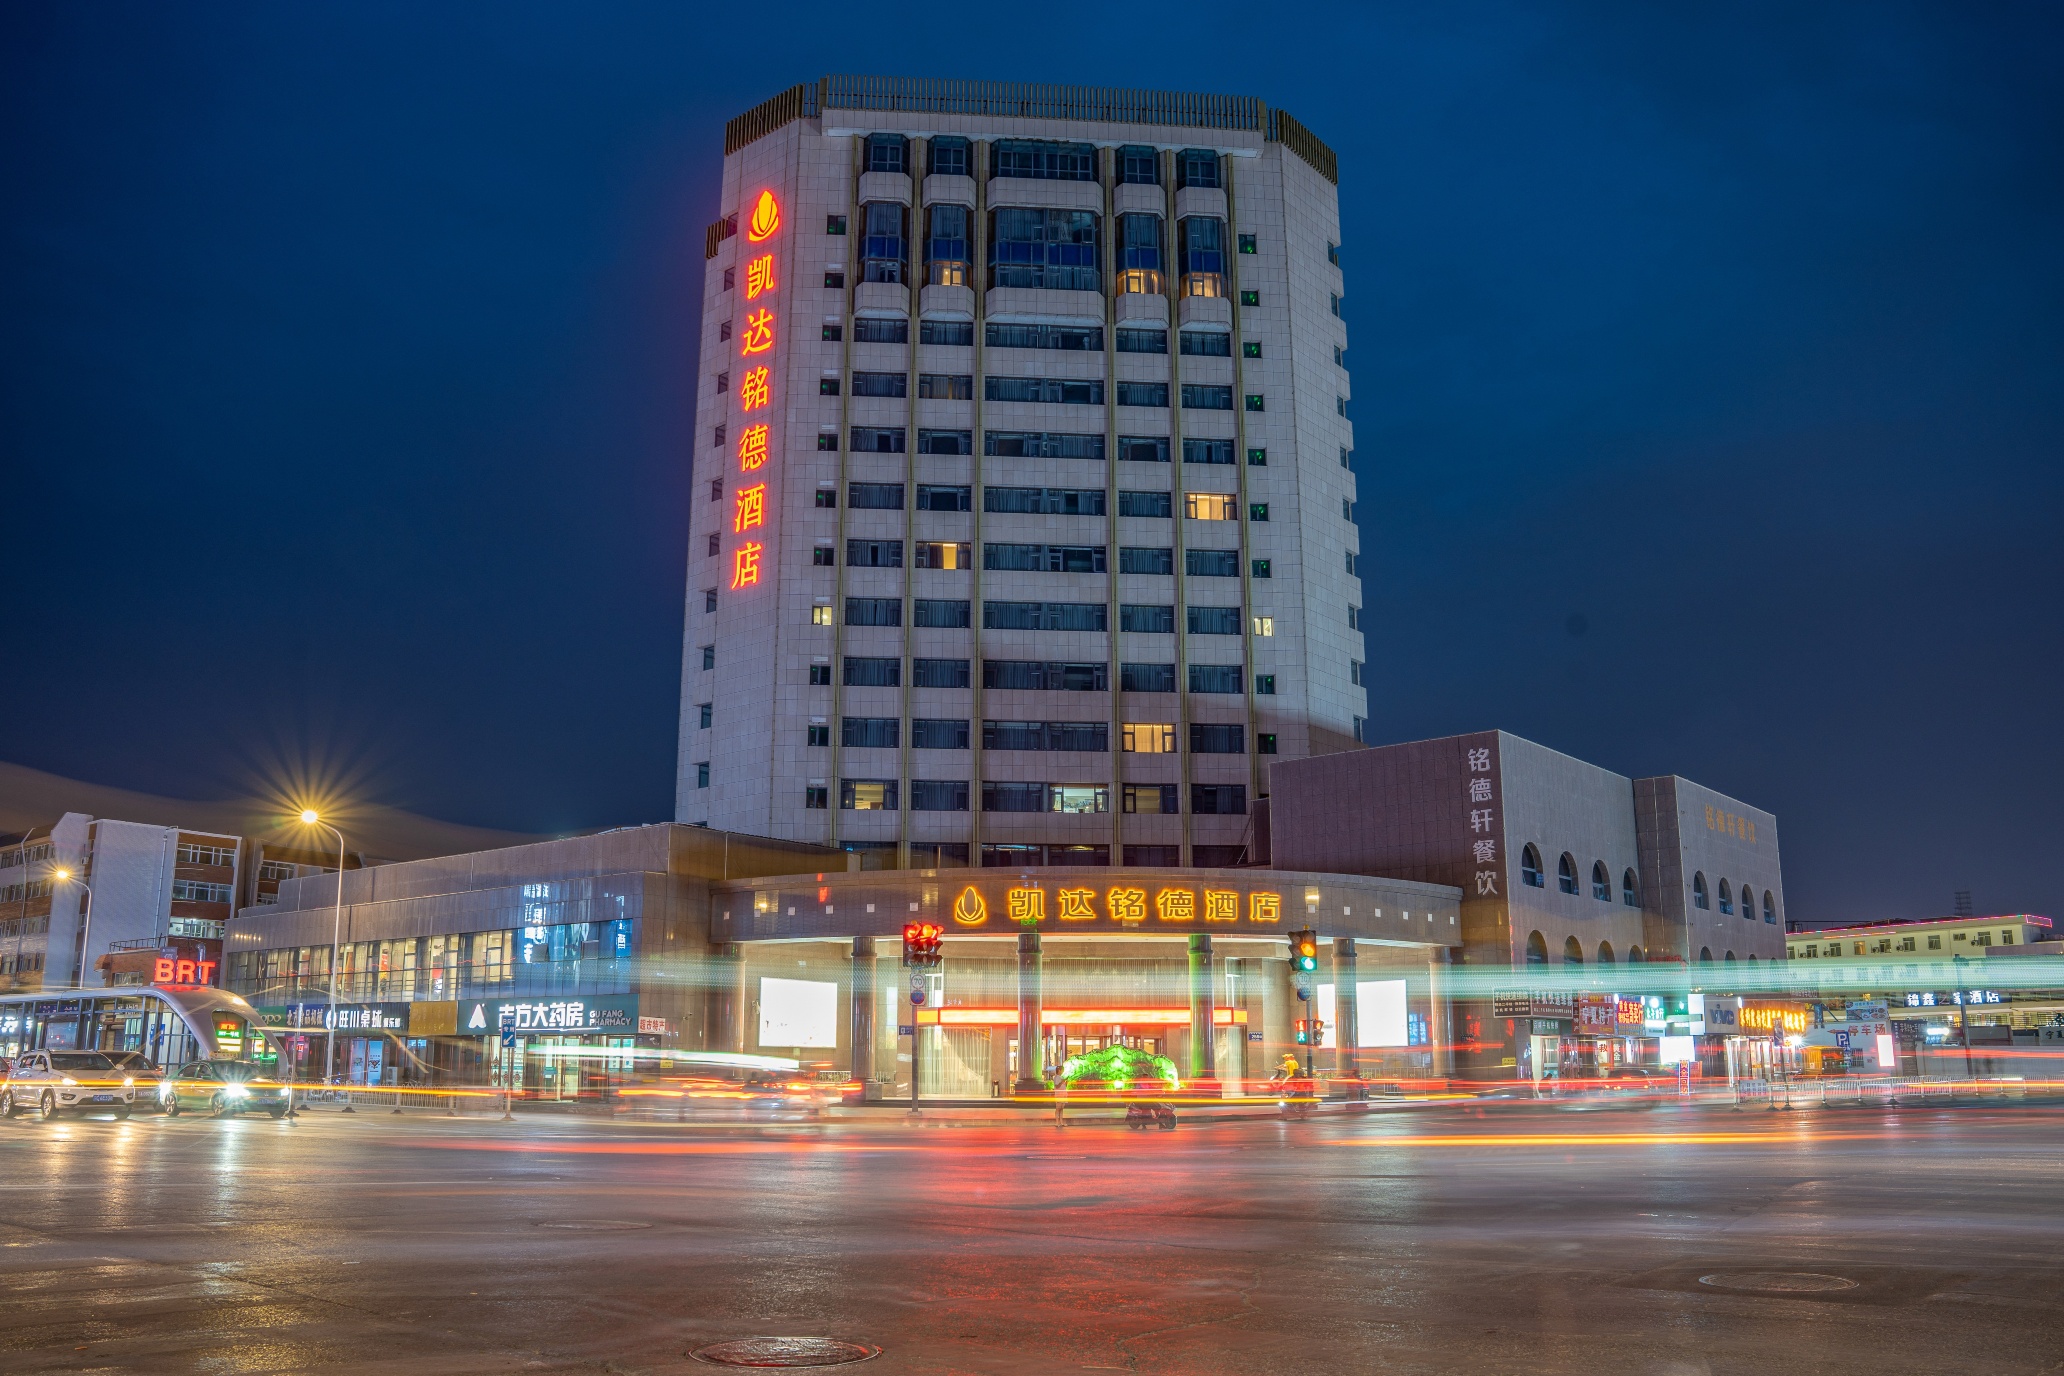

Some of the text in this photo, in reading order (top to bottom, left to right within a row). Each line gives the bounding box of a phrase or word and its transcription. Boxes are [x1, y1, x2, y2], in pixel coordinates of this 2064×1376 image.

[732, 254, 775, 590] 凯达铭德酒店
[1467, 747, 1498, 896] 铭德轩餐饮
[1008, 887, 1282, 922] 凯达铭德酒店
[154, 958, 216, 985] BRT
[339, 1009, 382, 1028] 旺川桌球
[590, 1009, 623, 1018] GU FANG
[590, 1017, 632, 1026] PHARMACY
[1837, 1033, 1847, 1046] P
[1848, 1024, 1886, 1037] 停车场
